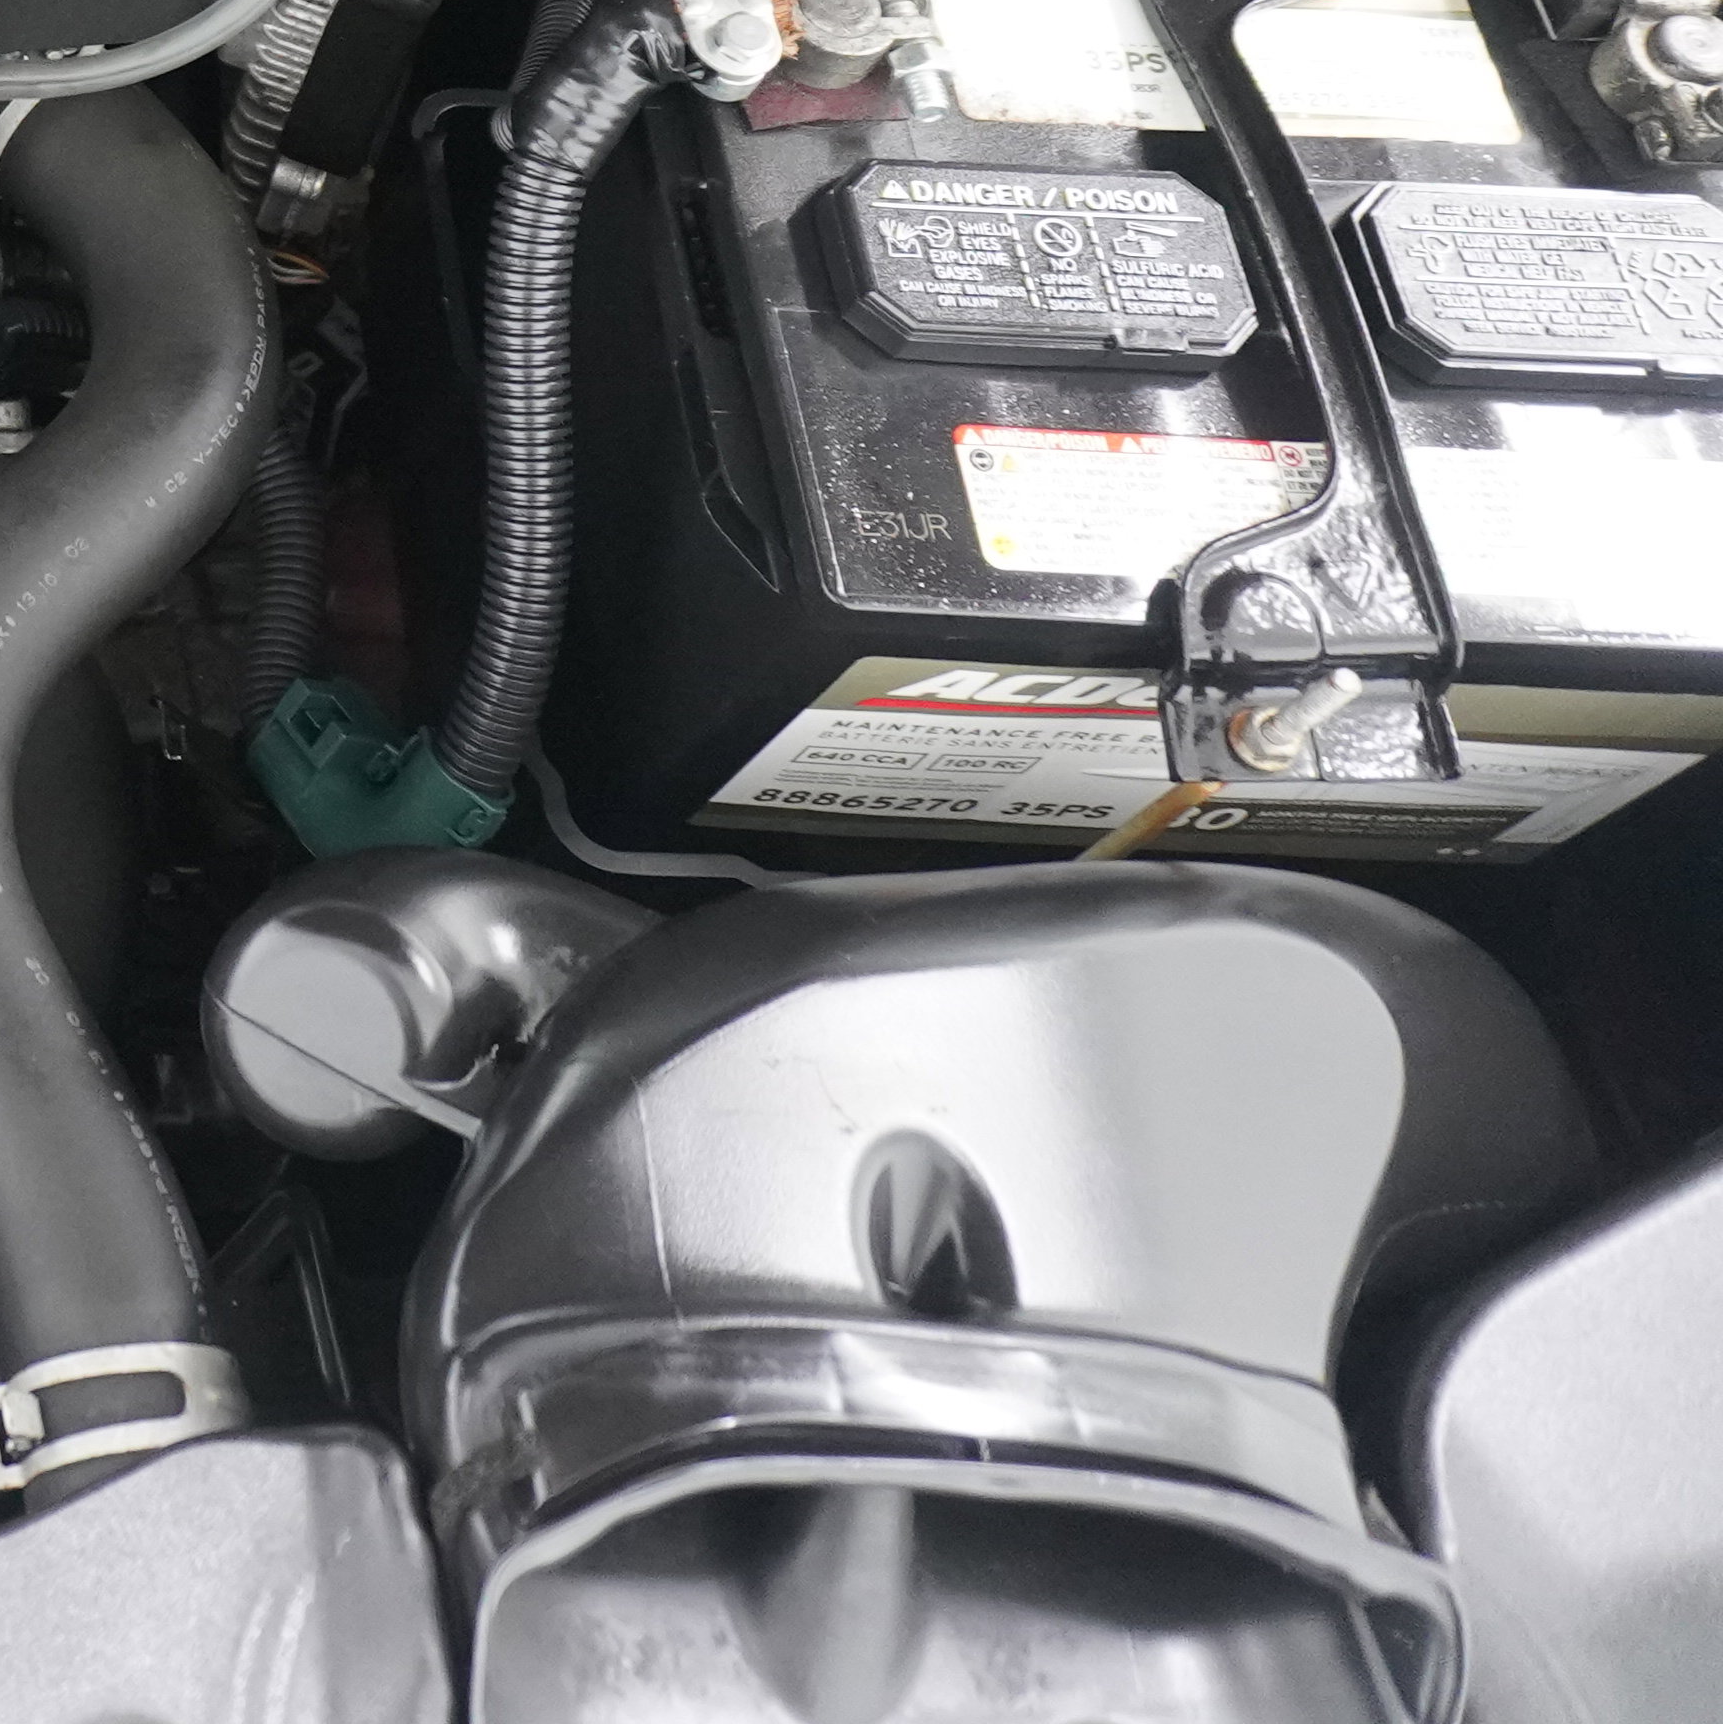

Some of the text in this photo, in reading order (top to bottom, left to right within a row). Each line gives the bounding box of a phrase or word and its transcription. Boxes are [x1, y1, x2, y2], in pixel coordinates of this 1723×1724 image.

[908, 180, 1035, 207] DANGER
[1065, 186, 1179, 214] POISON
[958, 221, 1012, 237] SHIELD
[961, 237, 1002, 251] EYES
[929, 250, 1011, 267] EXPLOSIVE
[1052, 259, 1077, 273] NO
[934, 266, 984, 281] GASES
[1112, 260, 1225, 280] SULFURIC ACID
[899, 279, 1027, 298] CAN CAUSE BLINDNESS
[1041, 274, 1093, 287] SPARKS
[1117, 276, 1191, 291] CAN CAUSE
[1044, 286, 1097, 300] FLAMES
[938, 295, 1000, 310] OR INJURY
[1048, 299, 1109, 314] SMOKING
[16, 591, 37, 612] 13
[191, 414, 239, 466] Y-TEC
[833, 720, 1039, 740] MAINTENANCE
[1054, 730, 1131, 743] FREE
[818, 731, 1160, 756] BATTERIE SANS ENTRETIEN
[805, 749, 1028, 771] 640 CCA 100 RC
[752, 787, 1115, 820] 88865270 35PS
